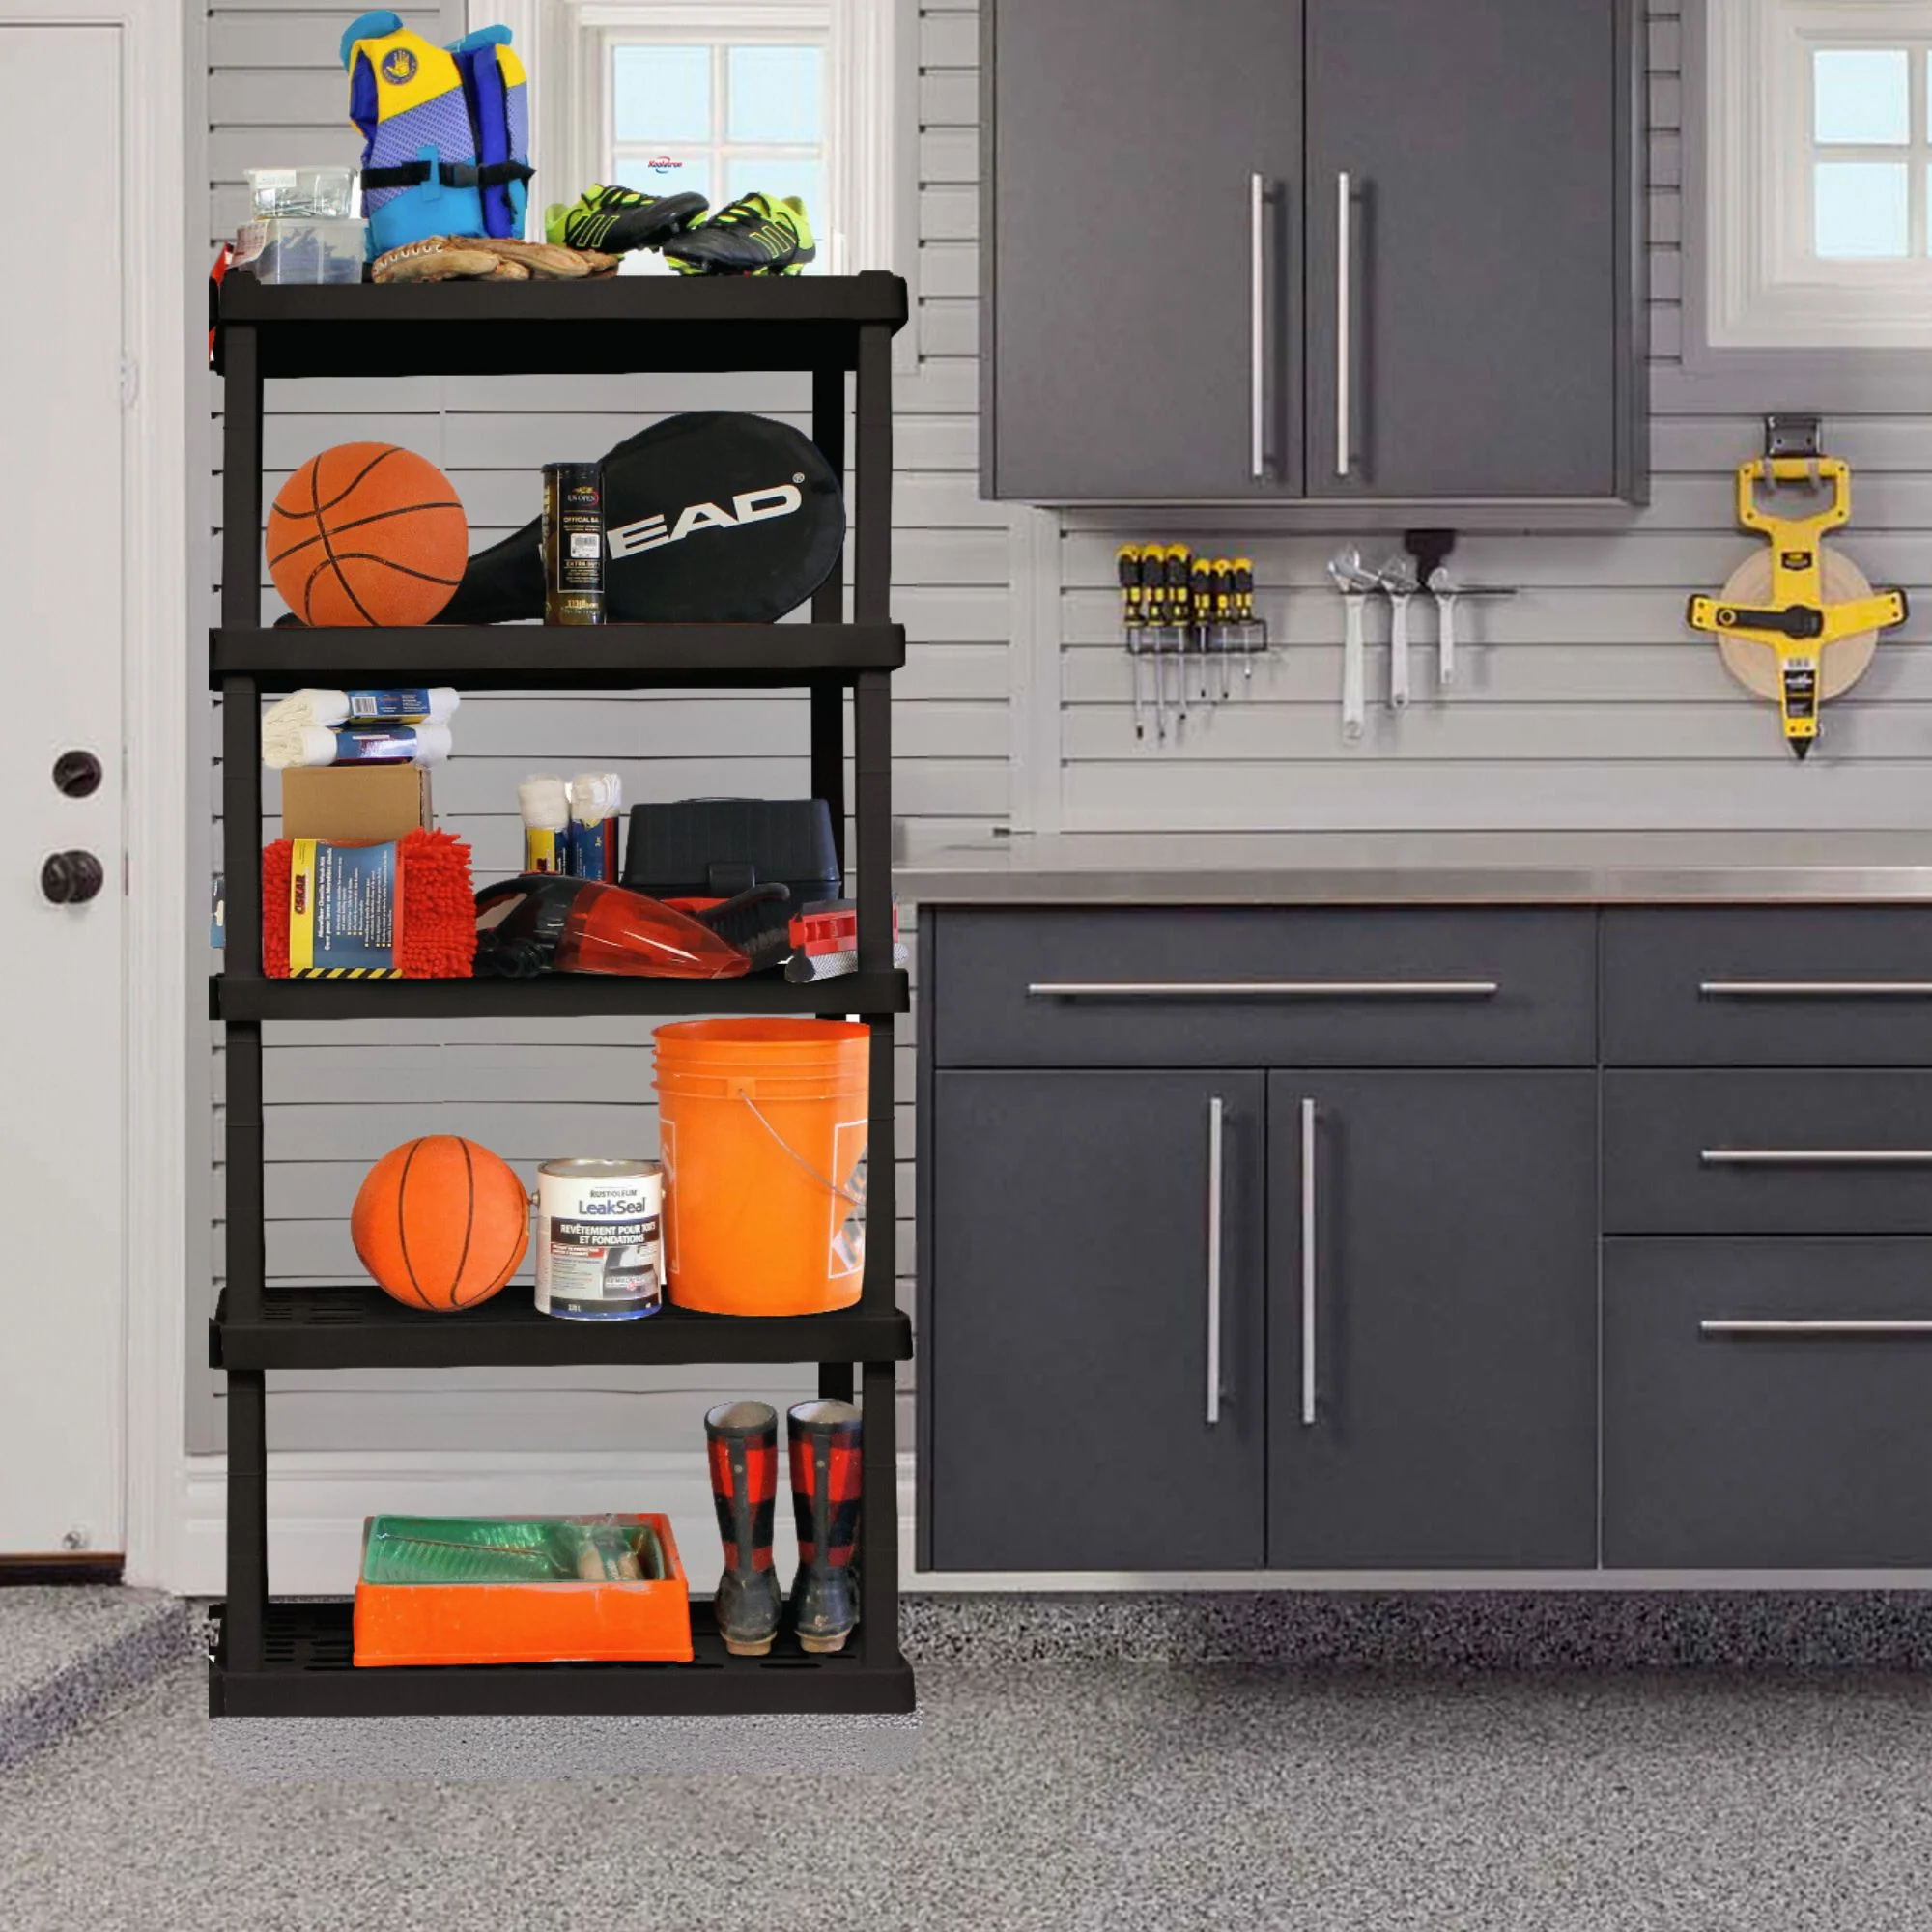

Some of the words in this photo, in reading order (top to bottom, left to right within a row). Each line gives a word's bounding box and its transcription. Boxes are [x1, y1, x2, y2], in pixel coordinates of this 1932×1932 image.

[538, 483, 802, 561] EAD
[578, 1196, 646, 1215] LeakSeal
[618, 1224, 640, 1235] POUR
[579, 1236, 590, 1244] ET
[591, 1234, 645, 1244] FONDATIONS
